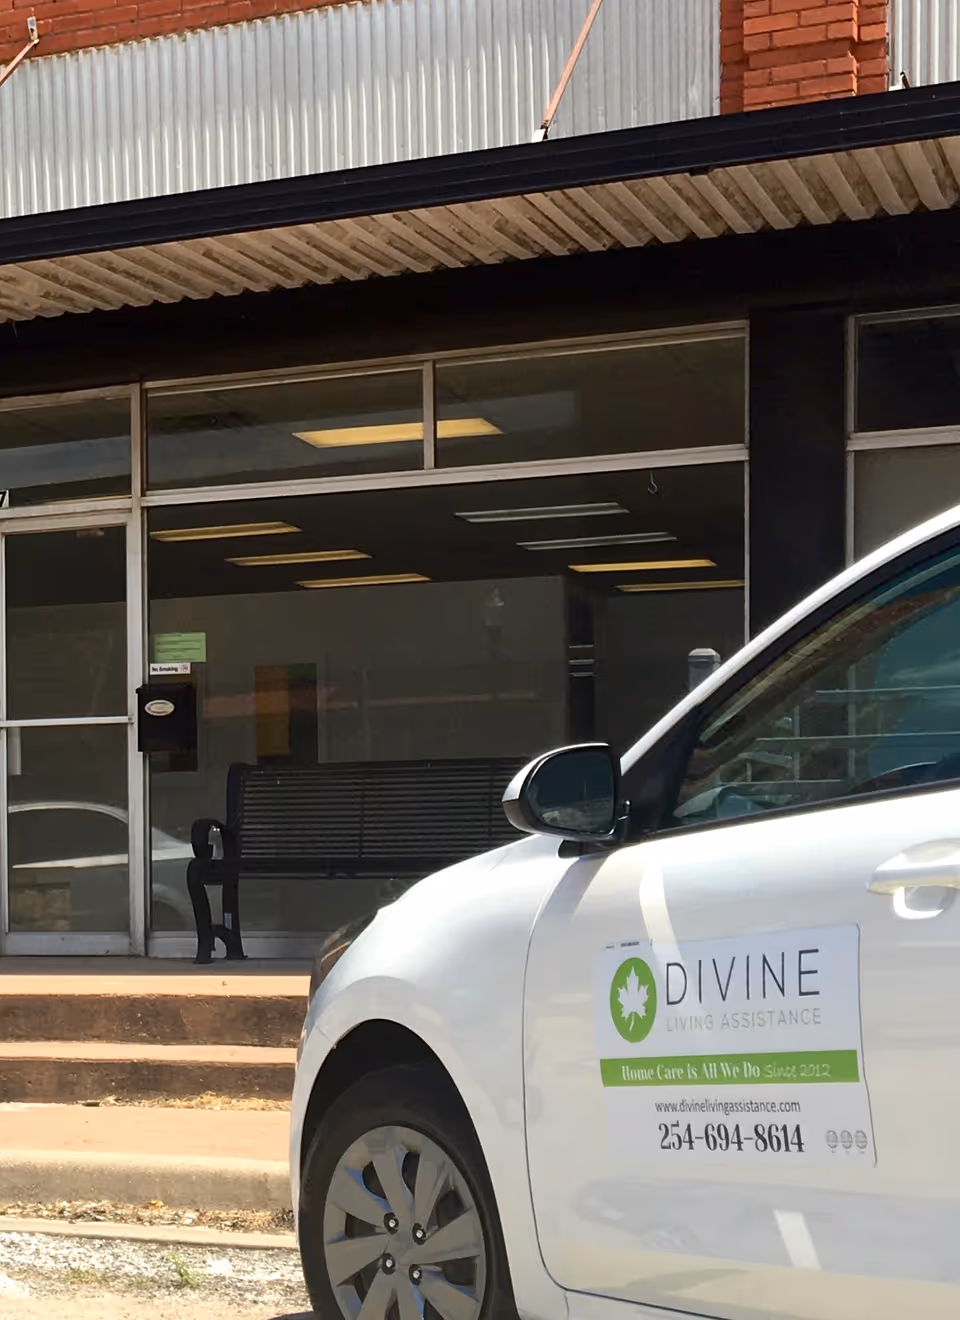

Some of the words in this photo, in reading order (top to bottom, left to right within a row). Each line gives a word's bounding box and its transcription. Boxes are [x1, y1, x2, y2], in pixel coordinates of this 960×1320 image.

[665, 948, 821, 1006] DIVINE
[666, 1013, 714, 1032] LIVING
[721, 1007, 823, 1030] ASSISTANCE
[621, 1065, 655, 1081] Home
[656, 1064, 685, 1081] Care
[687, 1063, 698, 1079] is
[702, 1062, 718, 1079] All
[720, 1062, 740, 1079] We
[743, 1061, 761, 1078] Do
[764, 1062, 798, 1078] Since
[799, 1062, 832, 1078] 2012
[654, 1099, 802, 1116] www.divinelivingassistance.com
[657, 1120, 806, 1153] 254-694-8614
